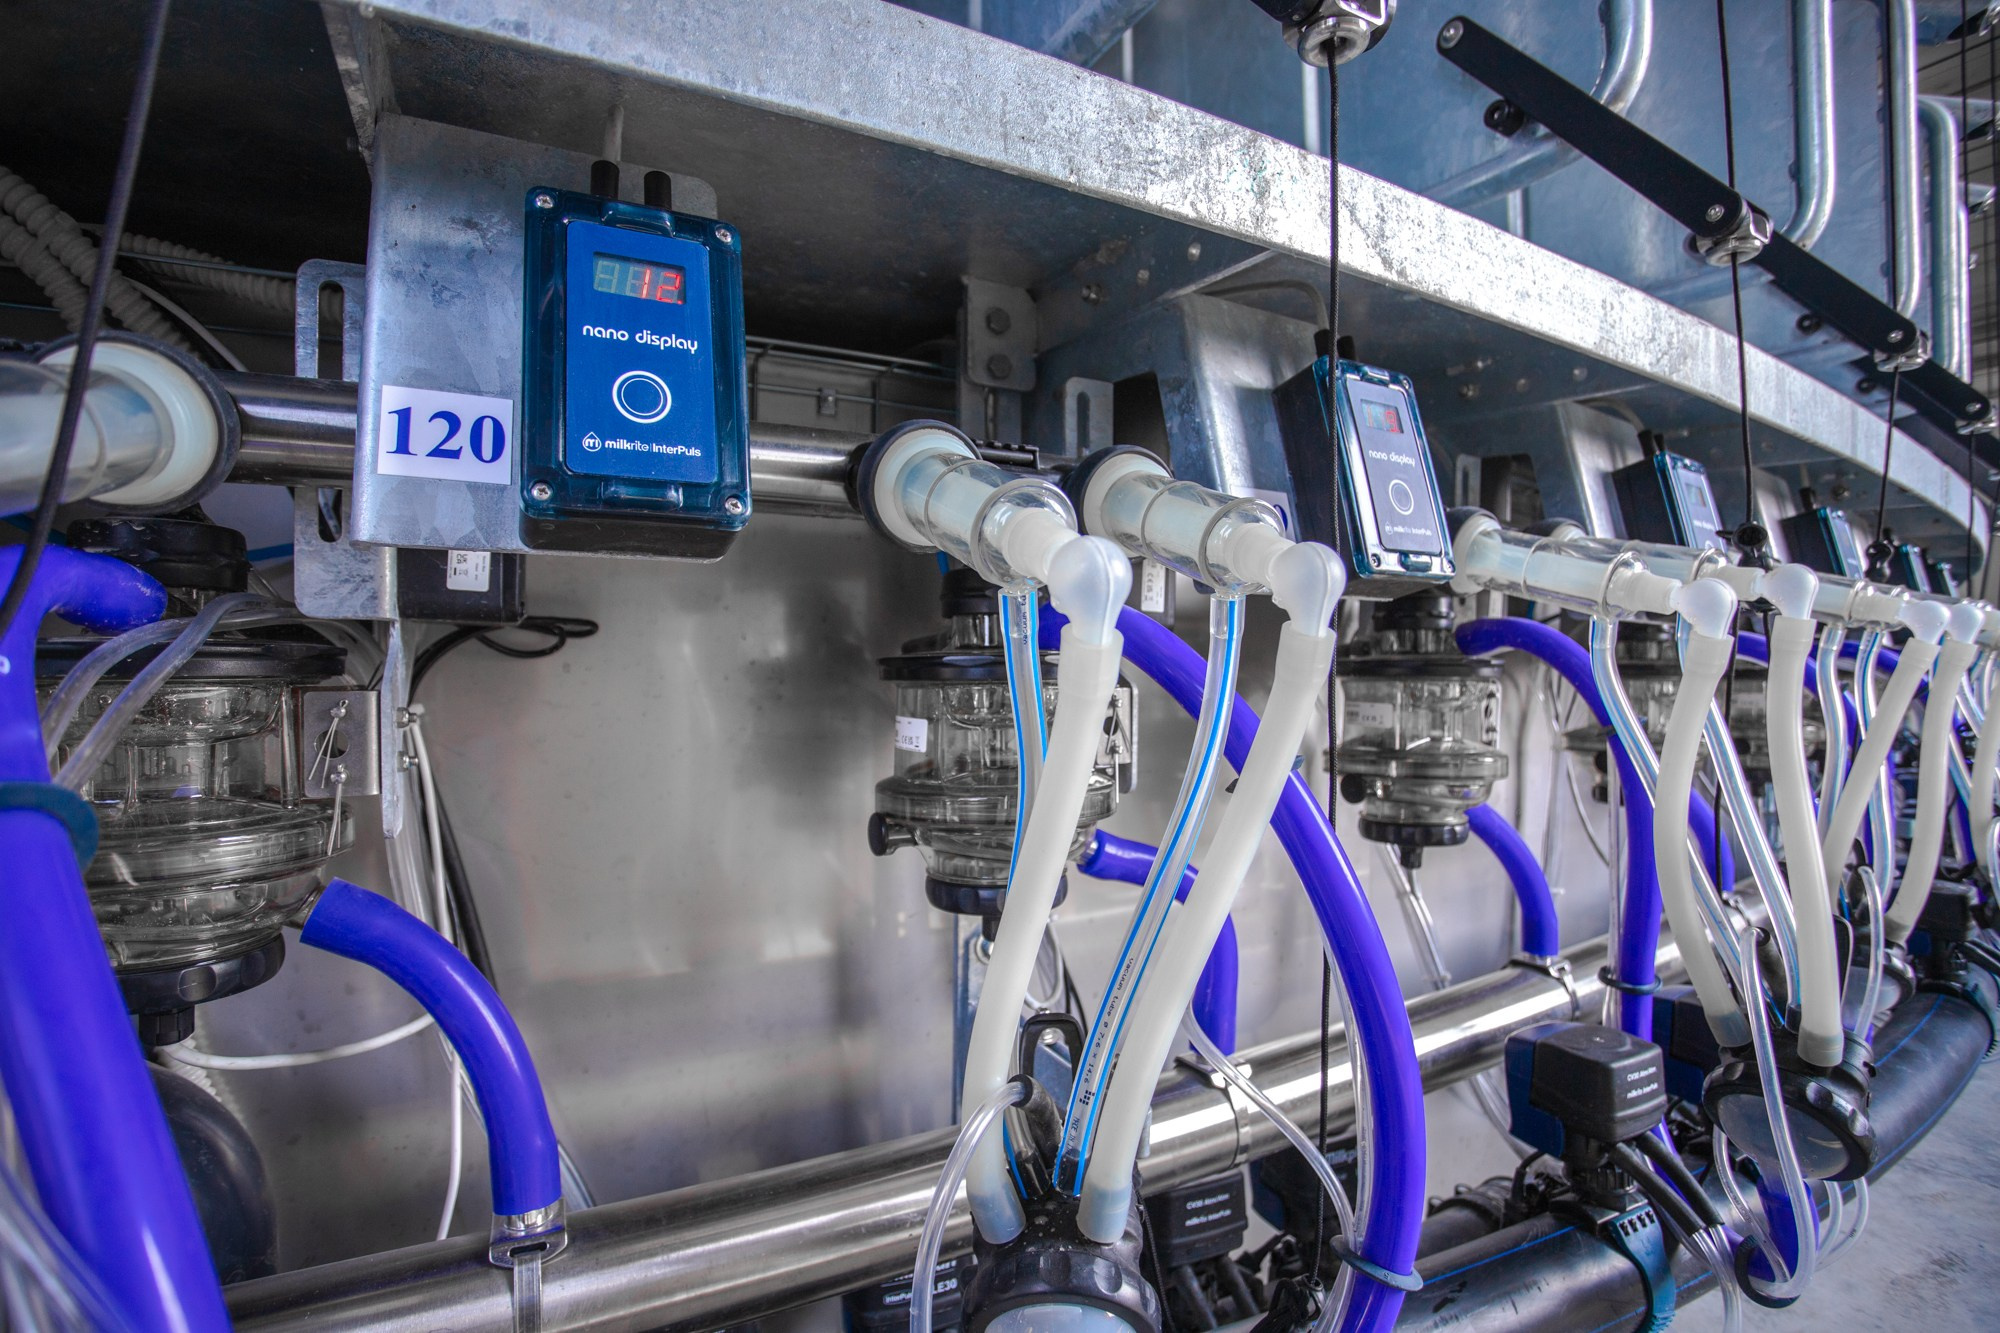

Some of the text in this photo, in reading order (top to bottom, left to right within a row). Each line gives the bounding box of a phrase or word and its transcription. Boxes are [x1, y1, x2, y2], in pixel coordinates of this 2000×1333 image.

[582, 324, 698, 354] nano display
[386, 406, 506, 464] 120
[652, 443, 702, 457] InterPuls
[1117, 957, 1134, 991] vacuum
[1107, 995, 1119, 1017] tube
